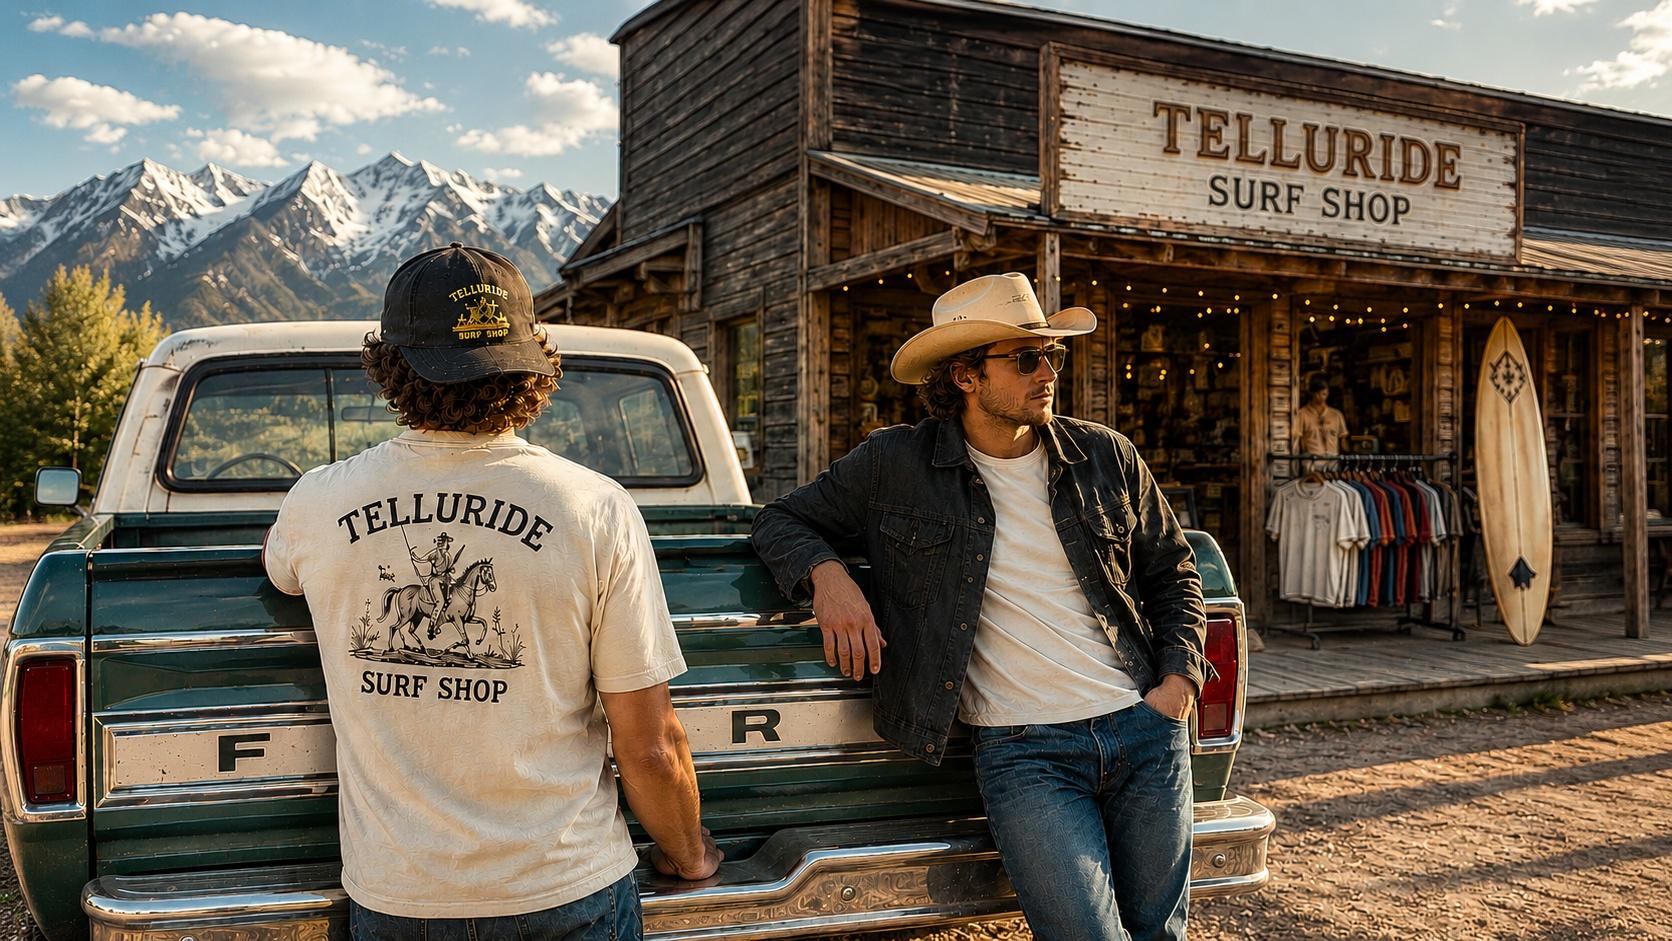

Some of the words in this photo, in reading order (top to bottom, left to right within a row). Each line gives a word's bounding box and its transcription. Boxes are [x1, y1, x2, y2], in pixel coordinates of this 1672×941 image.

[1154, 101, 1461, 190] TELLURIDE
[1208, 175, 1305, 214] SURF
[1321, 187, 1411, 225] SHOP
[448, 283, 509, 302] TELLURIDE
[486, 328, 509, 338] SHOP
[337, 492, 553, 552] TELLURIDE
[361, 671, 427, 698] SURF
[438, 677, 507, 703] SHOP
